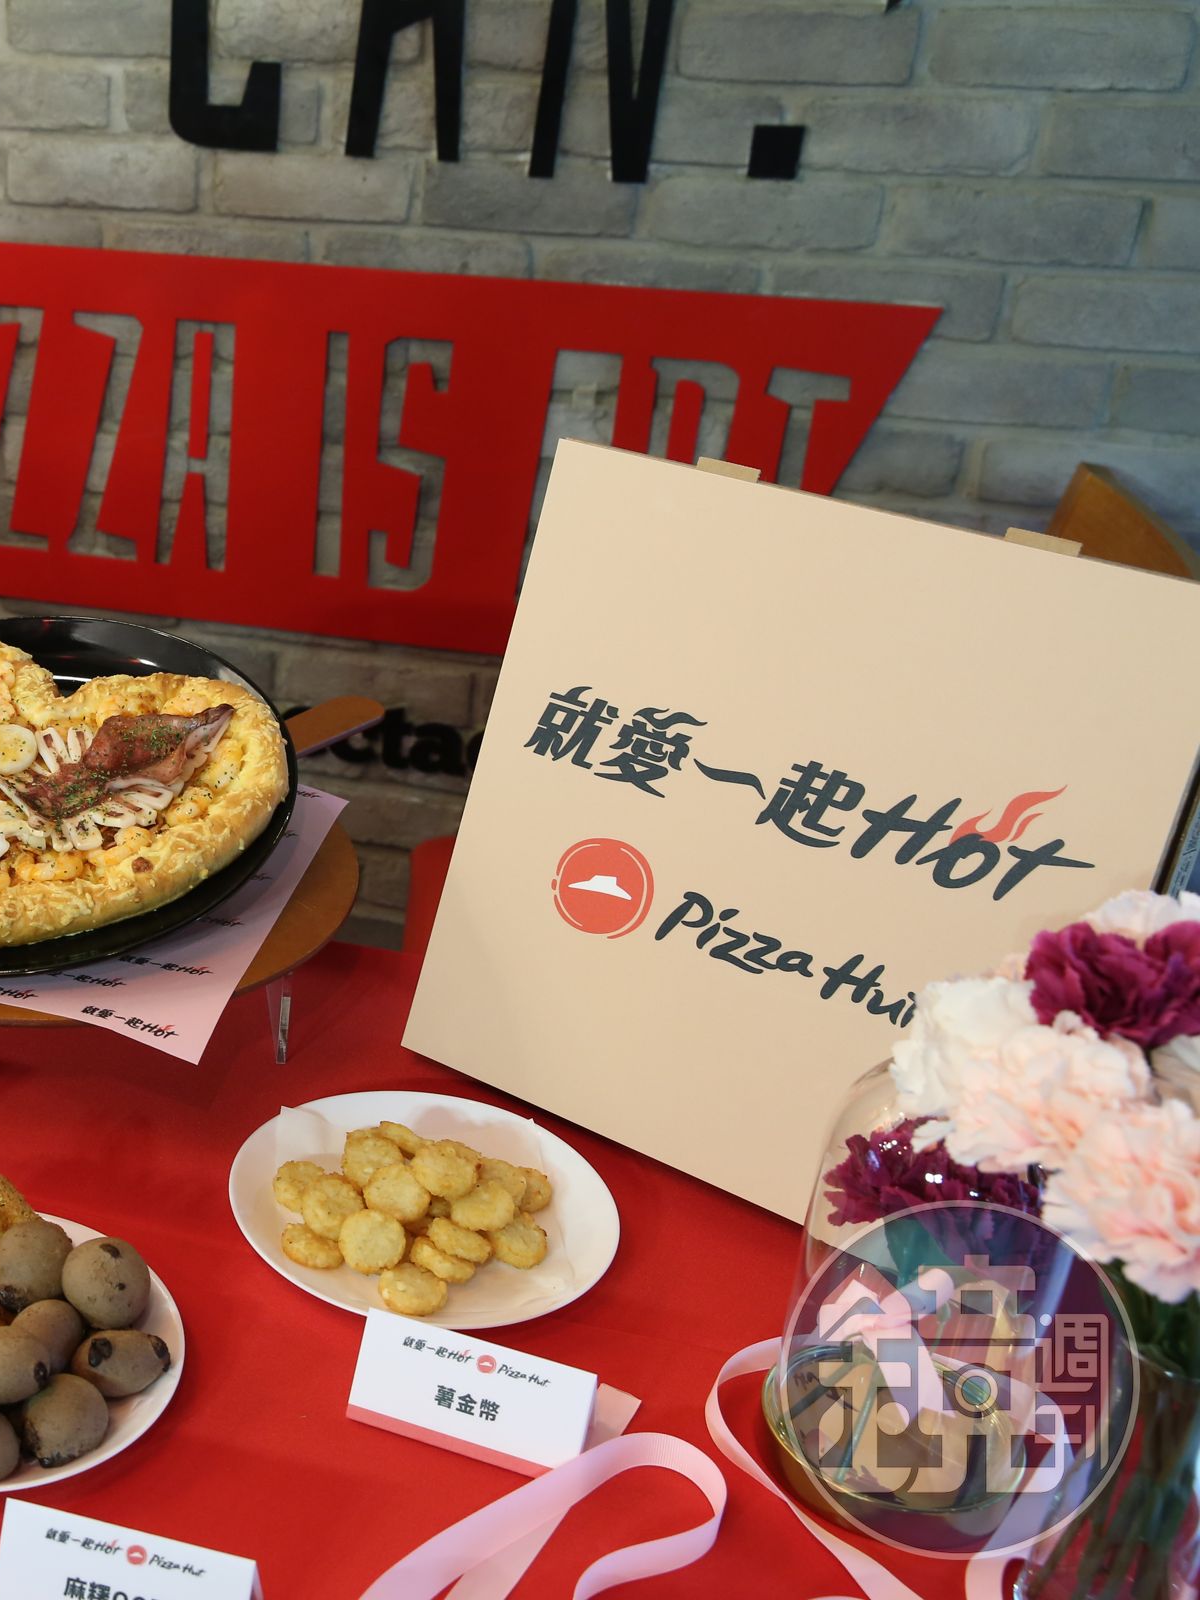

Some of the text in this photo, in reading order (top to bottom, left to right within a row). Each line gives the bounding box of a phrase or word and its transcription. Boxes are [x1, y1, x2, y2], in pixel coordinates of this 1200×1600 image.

[312, 330, 455, 591] IS
[655, 891, 814, 975] Pizza
[497, 1364, 527, 1380] Pizza
[528, 1374, 552, 1387] Hut
[434, 1385, 501, 1422] 薯金幣
[148, 1554, 181, 1571] Pizza
[182, 1563, 206, 1577] Hut
